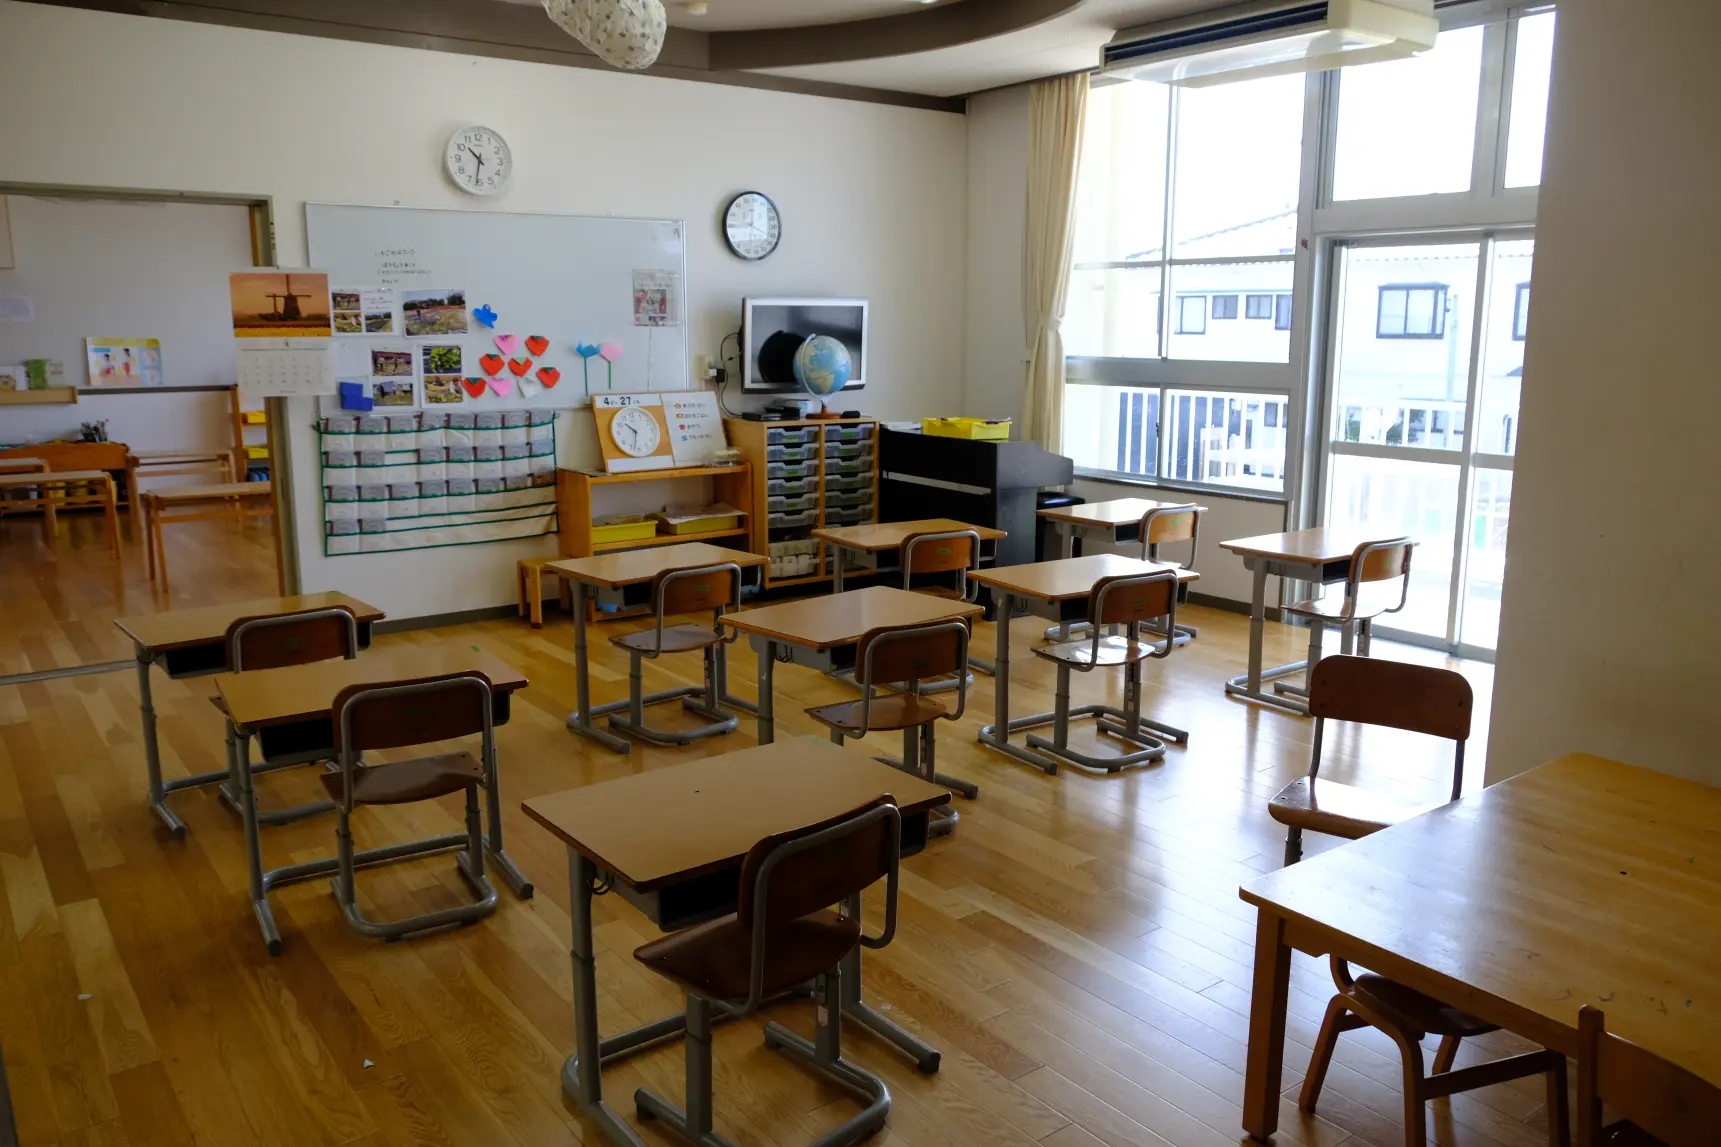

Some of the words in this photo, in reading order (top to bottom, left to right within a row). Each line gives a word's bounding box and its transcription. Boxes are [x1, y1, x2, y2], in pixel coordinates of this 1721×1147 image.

[464, 135, 472, 144] 11
[474, 133, 483, 142] 12
[457, 143, 466, 152] 10
[494, 145, 501, 155] 2
[454, 153, 462, 163] 9
[497, 157, 504, 166] 3
[458, 165, 465, 175] 8
[494, 168, 501, 176] 4
[466, 174, 472, 183] 7
[487, 177, 495, 185] 5
[603, 396, 610, 406] 4
[619, 396, 631, 406] 27
